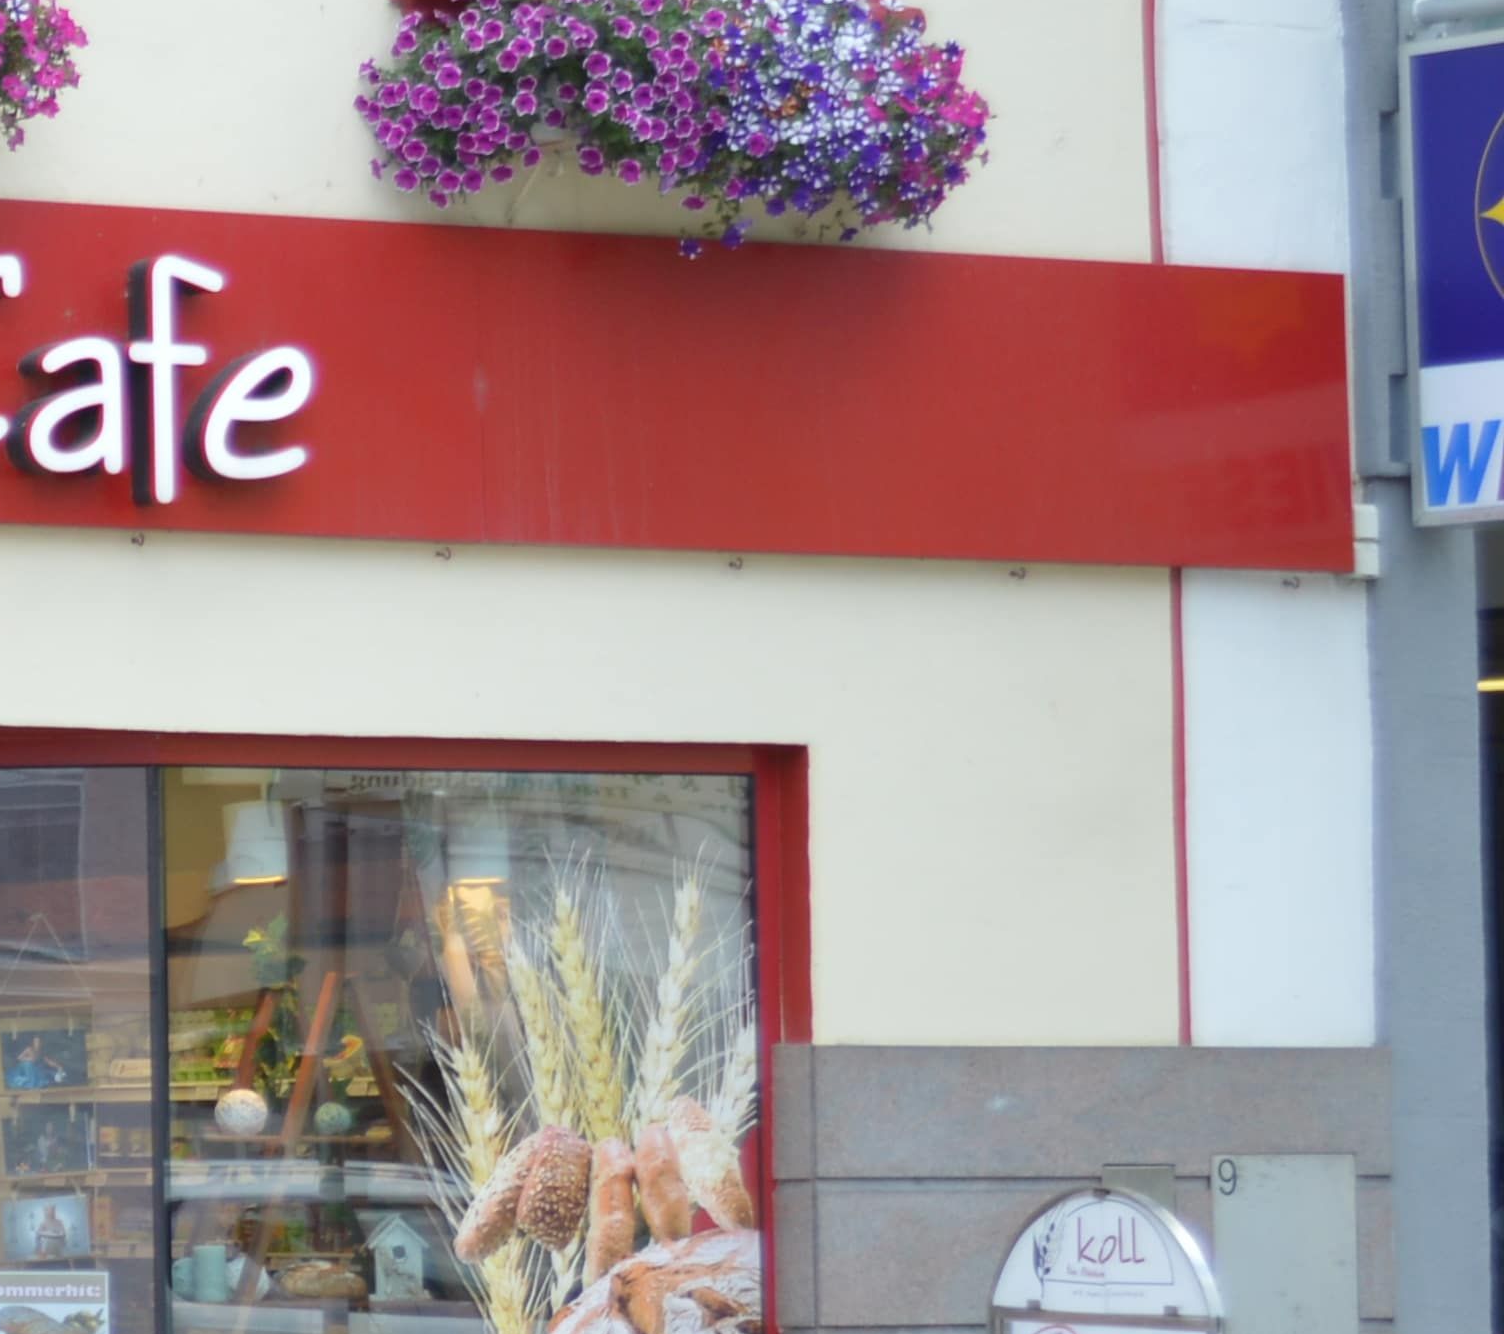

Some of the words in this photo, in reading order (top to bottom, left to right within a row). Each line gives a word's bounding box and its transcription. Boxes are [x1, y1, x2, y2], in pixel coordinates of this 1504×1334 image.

[1421, 419, 1504, 508] W
[1217, 1158, 1239, 1196] 9
[1077, 1216, 1145, 1264] koll
